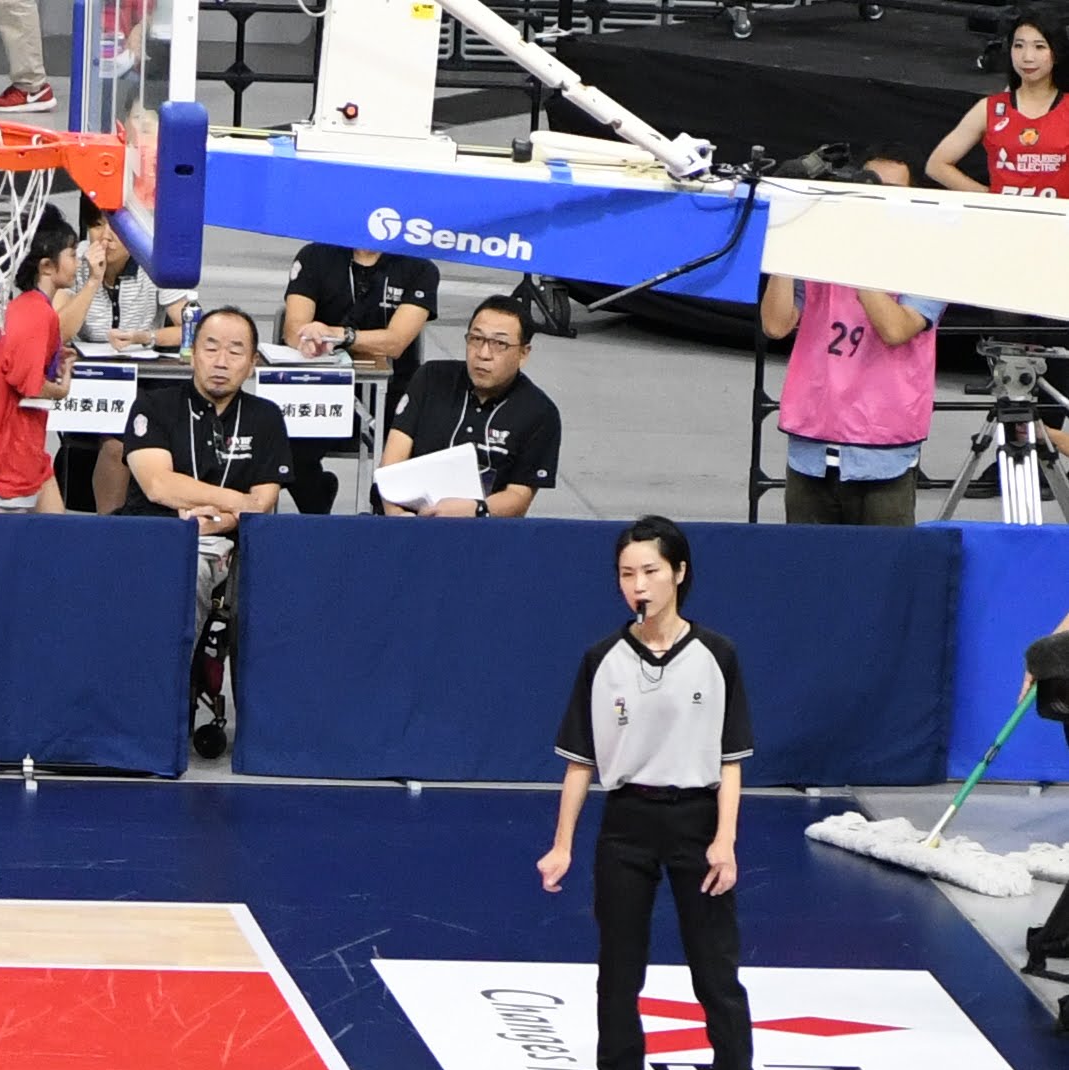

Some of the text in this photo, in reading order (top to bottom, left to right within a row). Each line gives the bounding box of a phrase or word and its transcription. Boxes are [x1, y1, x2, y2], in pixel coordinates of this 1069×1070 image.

[1017, 154, 1066, 163] MITSUBISHI
[1017, 163, 1060, 172] ELECTRIC
[403, 217, 533, 261] Senoh
[827, 321, 865, 358] 29
[480, 988, 578, 1063] Changes
